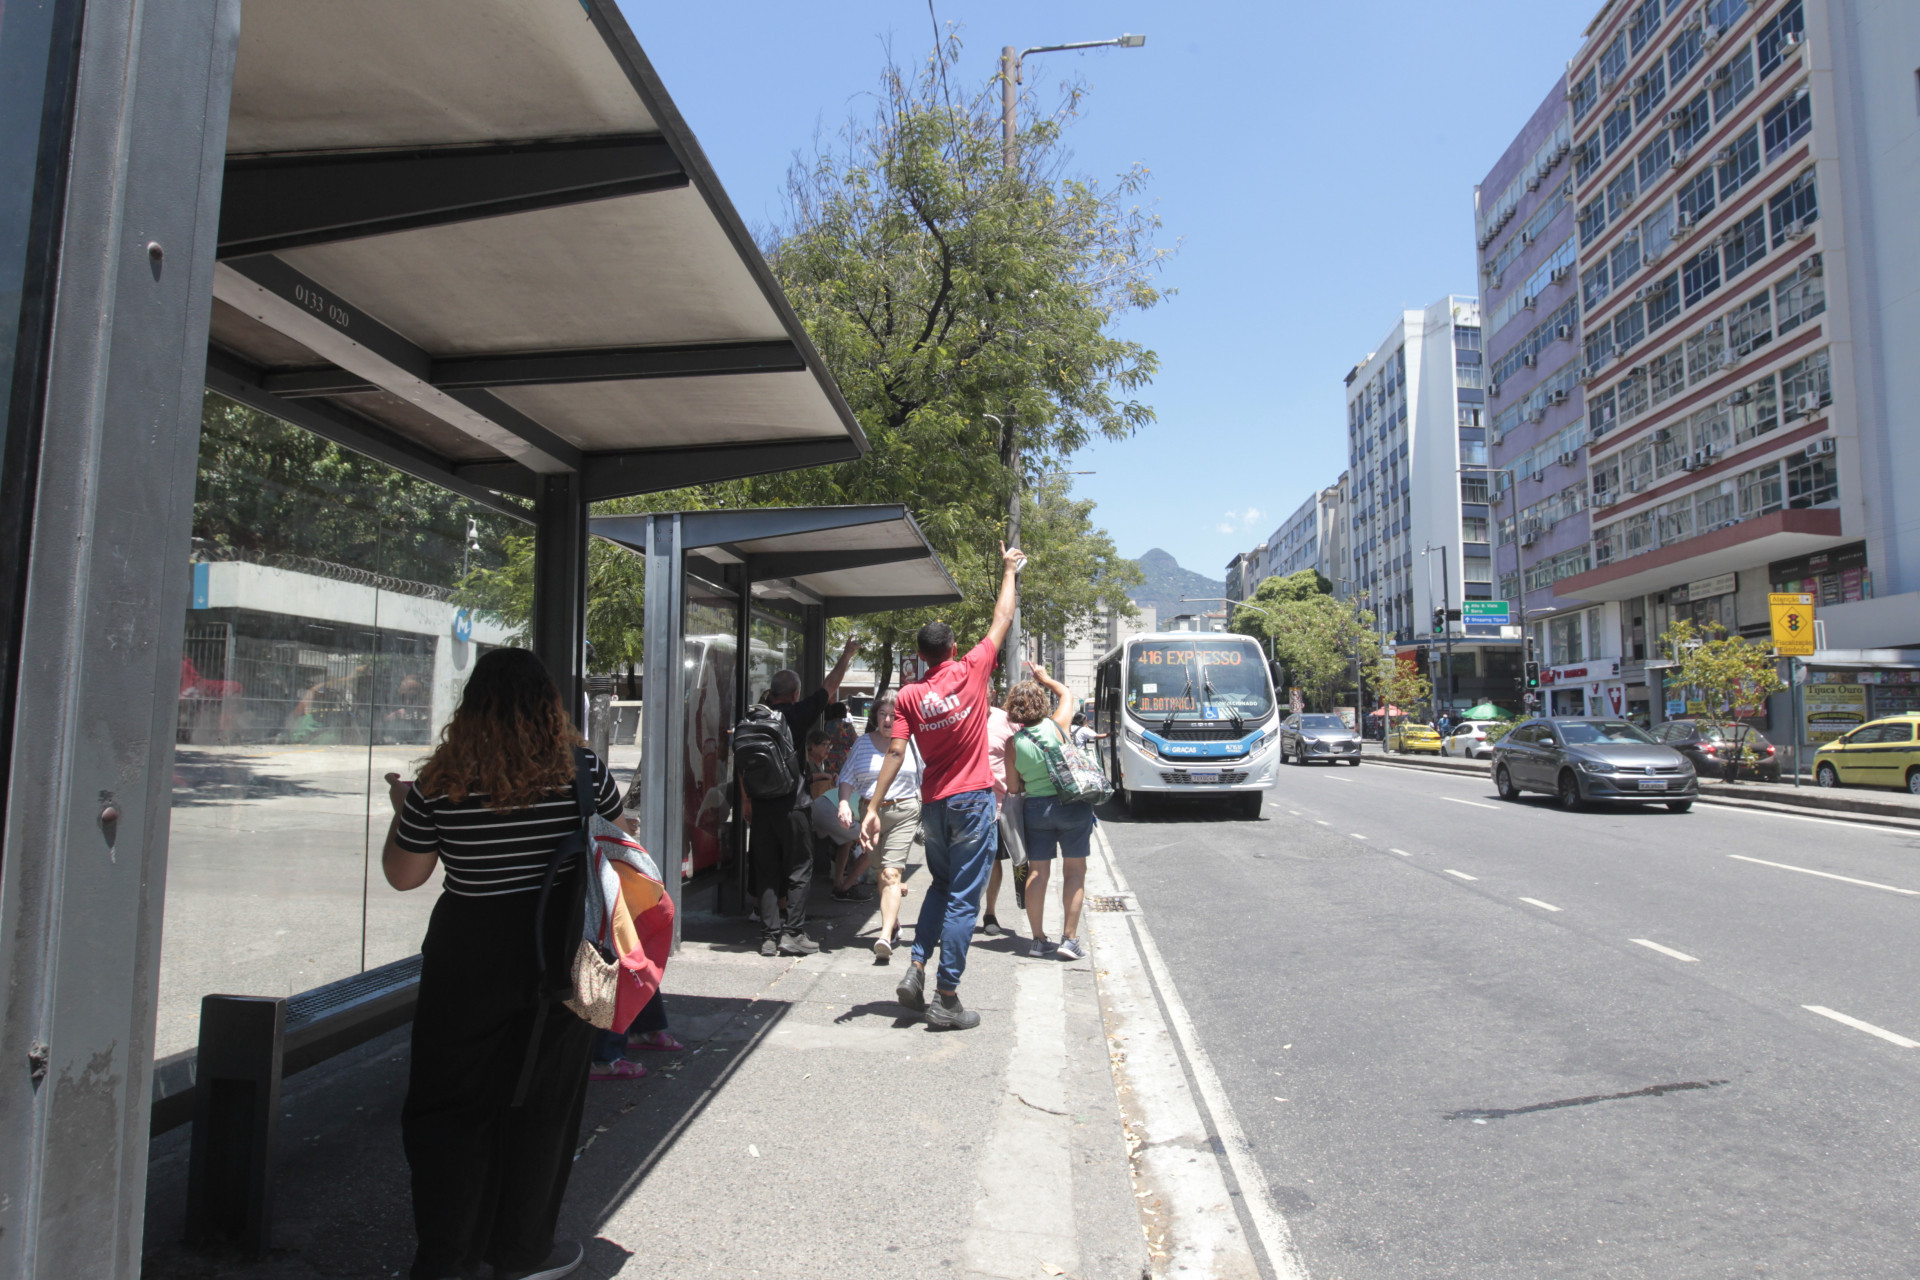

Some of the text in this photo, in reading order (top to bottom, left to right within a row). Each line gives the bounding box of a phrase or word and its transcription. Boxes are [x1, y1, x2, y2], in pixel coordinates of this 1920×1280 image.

[295, 284, 349, 327] 0133 020
[1138, 650, 1242, 666] 416 EXPRESSO
[1807, 685, 1863, 695] Tijuca Ouro
[919, 706, 972, 732] Promotor
[920, 694, 960, 720] kian
